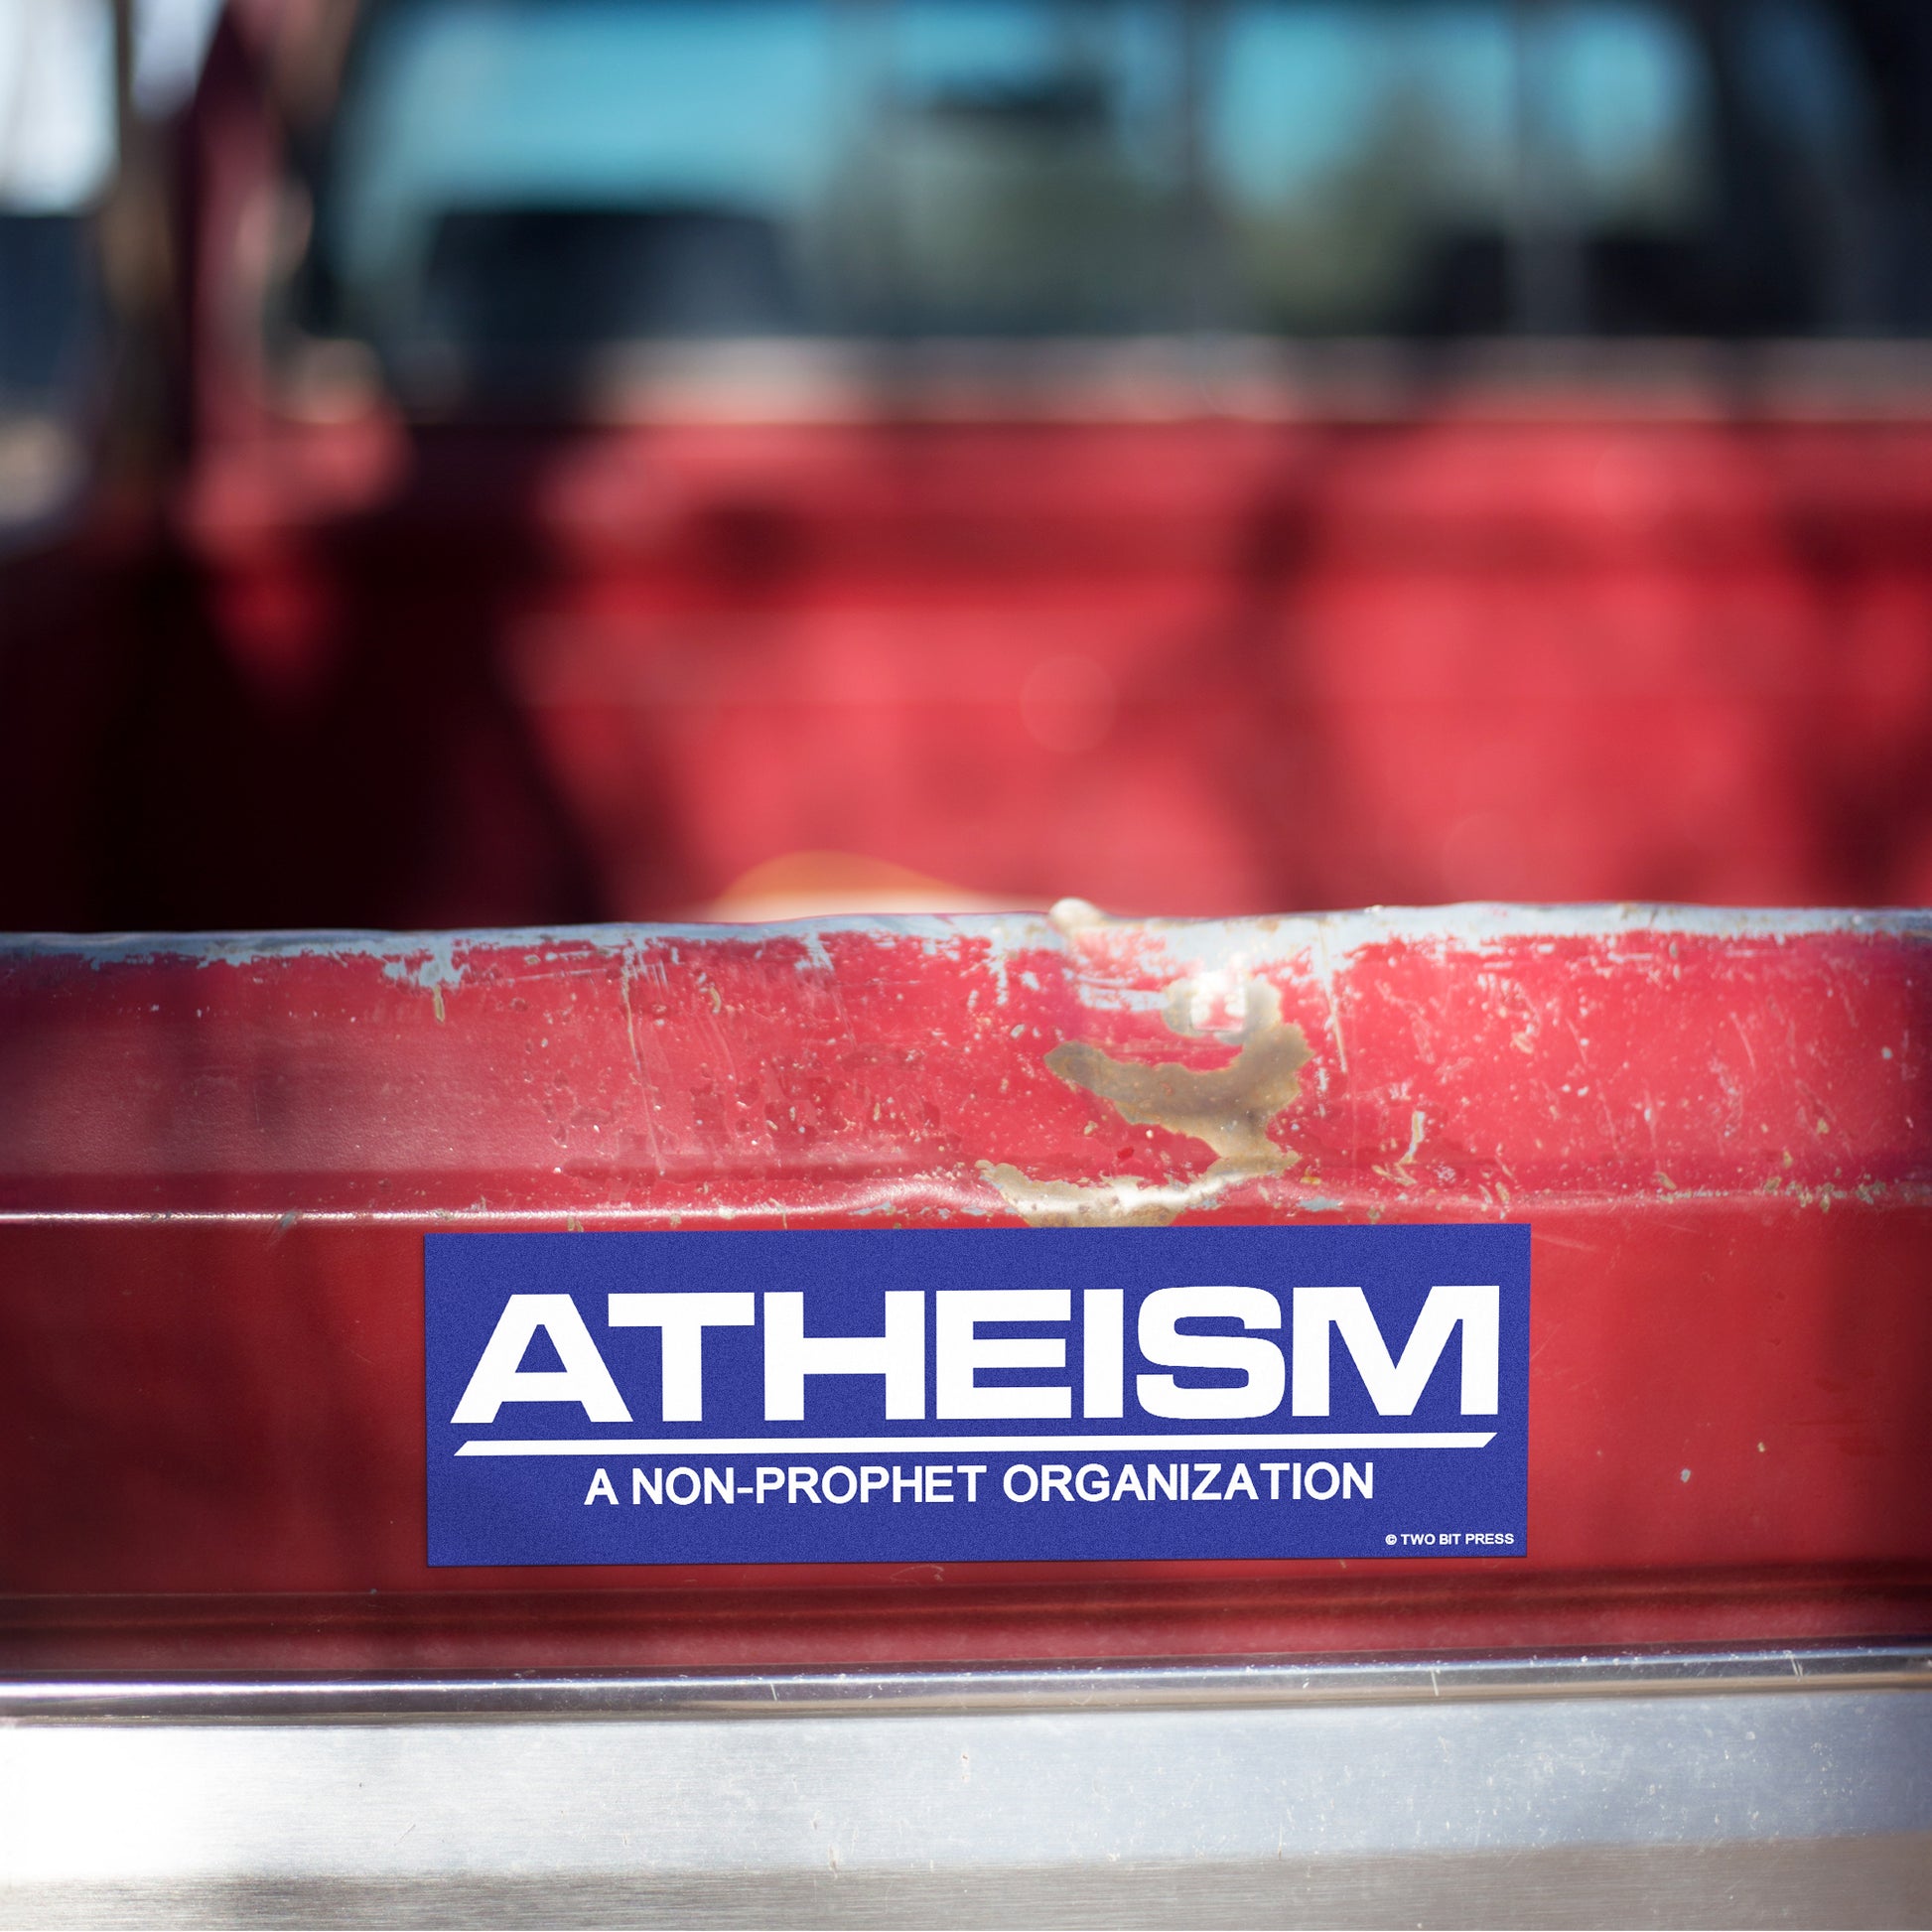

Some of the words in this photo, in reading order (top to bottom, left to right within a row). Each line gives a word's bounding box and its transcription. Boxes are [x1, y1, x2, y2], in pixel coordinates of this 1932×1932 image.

[450, 1285, 1500, 1424] ATHEISM
[583, 1467, 620, 1506] A
[631, 1464, 988, 1506] NON-PROPHET
[1003, 1461, 1374, 1503] ORGANIZATION
[1385, 1533, 1398, 1546] ©
[1400, 1533, 1437, 1546] TWO
[1439, 1533, 1462, 1546] BIT
[1464, 1533, 1515, 1545] PRESS
